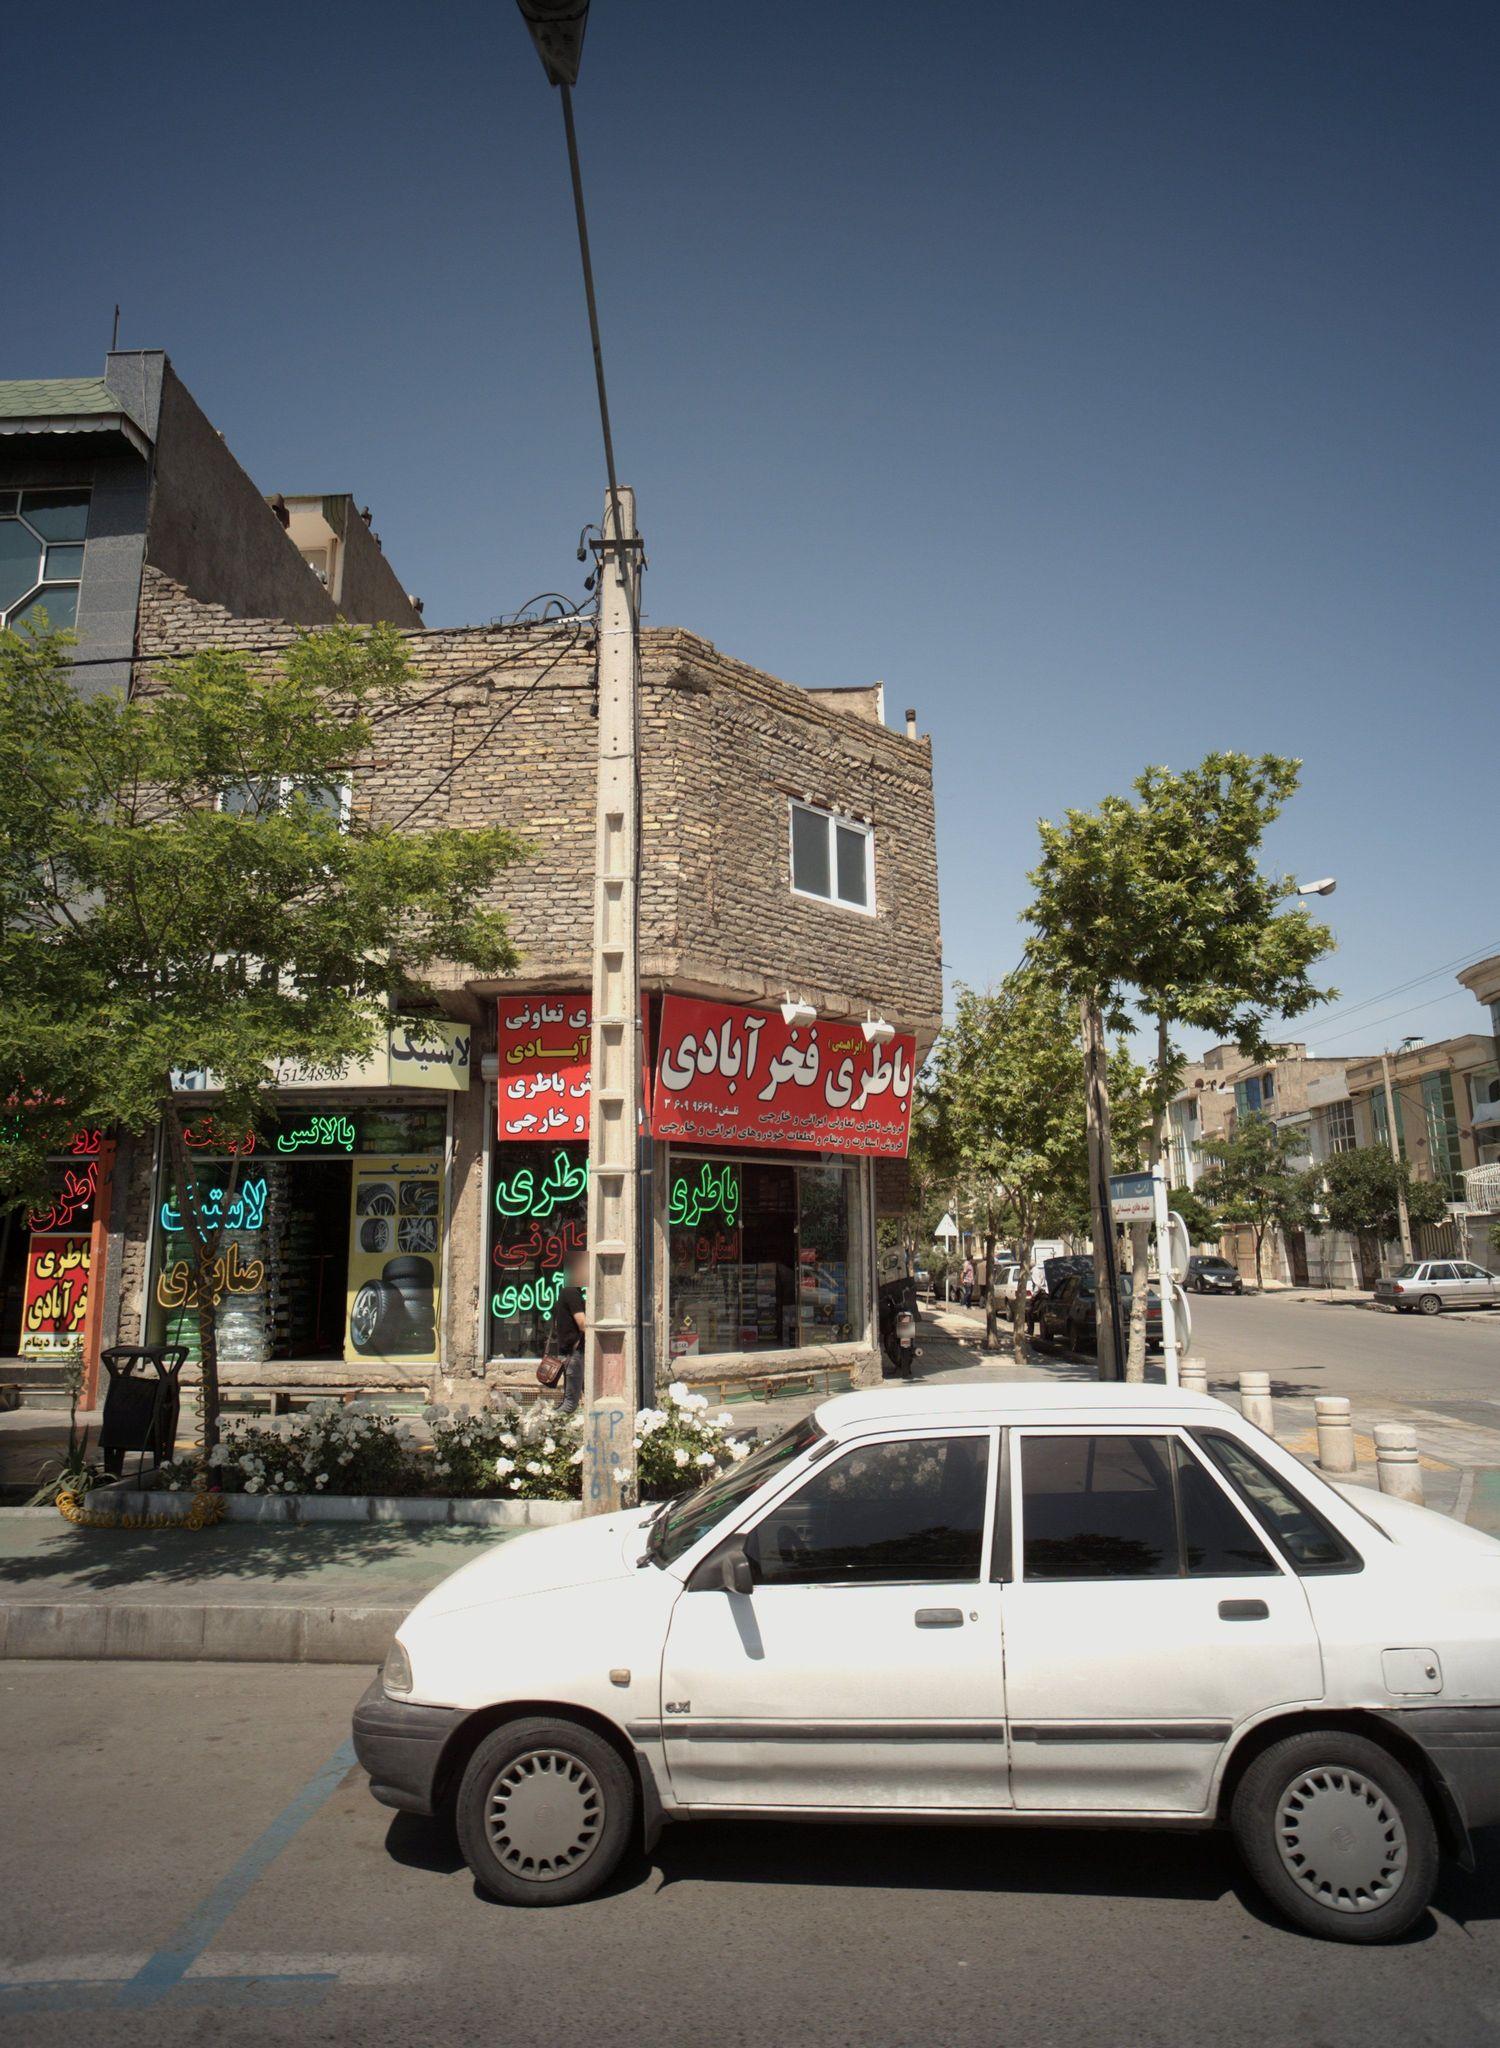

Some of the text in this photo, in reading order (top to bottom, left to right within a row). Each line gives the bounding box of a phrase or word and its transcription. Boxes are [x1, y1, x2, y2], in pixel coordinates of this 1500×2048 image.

[505, 1003, 563, 1029] تعاونی
[391, 1030, 471, 1071] لاستیک
[272, 1066, 349, 1083] 151248985
[661, 1015, 911, 1114] باطری فخر آبادی
[507, 1071, 565, 1098] باطری
[505, 1107, 585, 1133] و خارجی
[659, 1119, 697, 1134] خارجی
[698, 1122, 706, 1136] و
[758, 1108, 791, 1124] خارجی
[277, 1116, 356, 1153] بالانس
[706, 1122, 737, 1138] ایرانی
[738, 1125, 787, 1143] خودروهای
[358, 1162, 440, 1176] لاستیک
[495, 1150, 590, 1217] طری
[668, 1162, 739, 1227] باطری
[28, 1161, 99, 1233] اطری
[160, 1177, 269, 1243] لاستک
[492, 1220, 590, 1269] اونی
[27, 1279, 88, 1332] خر آبادی
[24, 1336, 50, 1352] دینام
